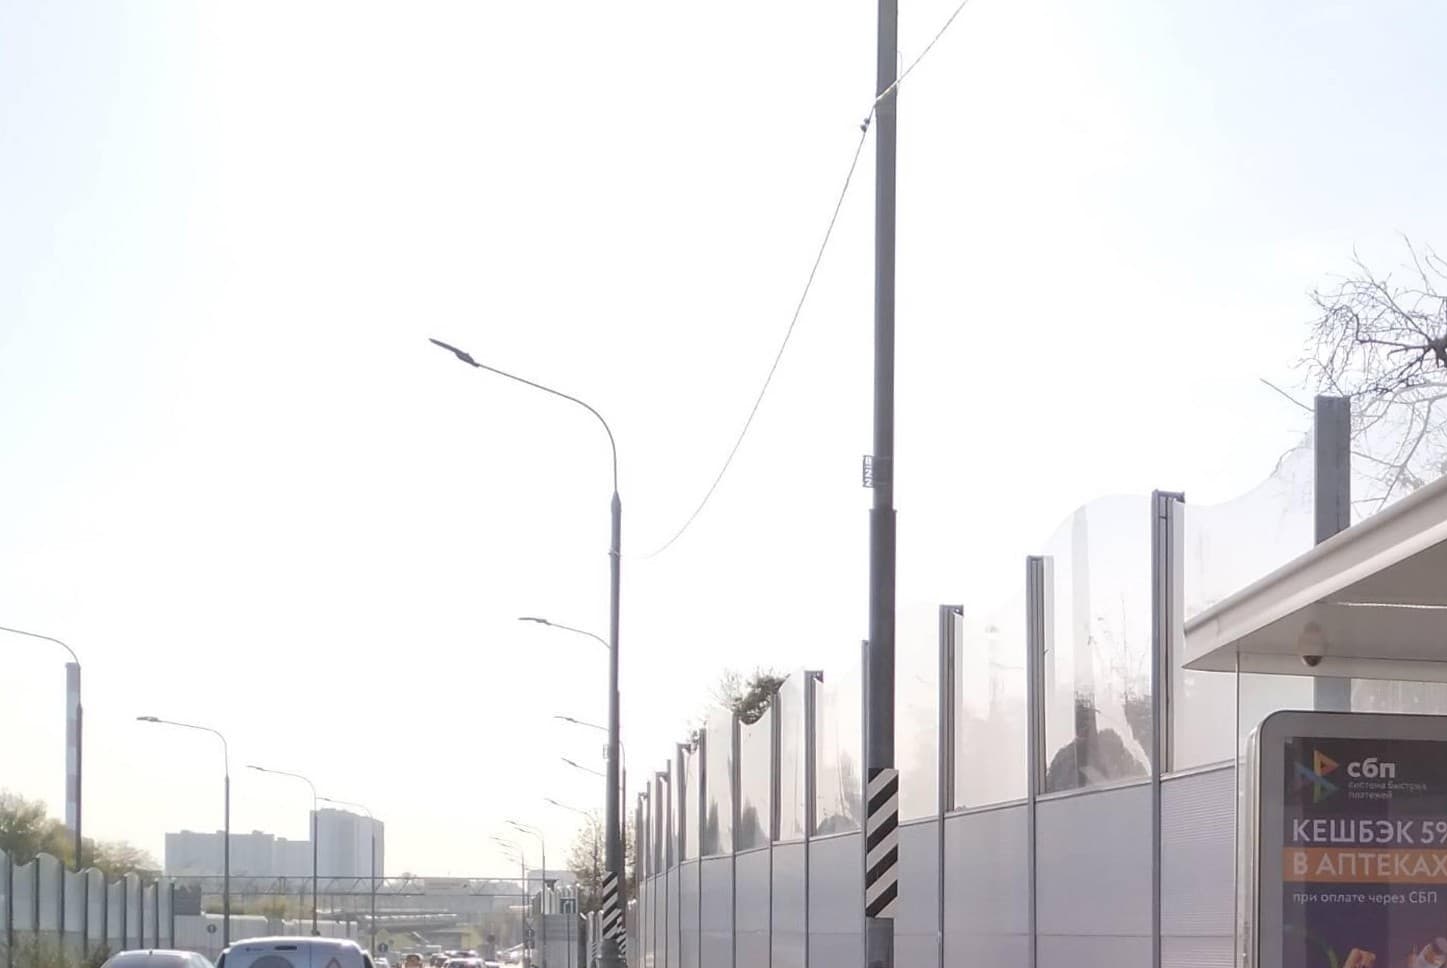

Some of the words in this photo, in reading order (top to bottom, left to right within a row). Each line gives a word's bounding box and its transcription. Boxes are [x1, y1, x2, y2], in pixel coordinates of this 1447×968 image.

[1347, 757, 1396, 779] сбп
[1292, 819, 1414, 844] КЕШБЭК
[1292, 852, 1309, 876] В
[1292, 893, 1318, 905] при
[1320, 893, 1366, 904] оплате
[1368, 894, 1406, 905] через
[1408, 890, 1438, 904] СБП
